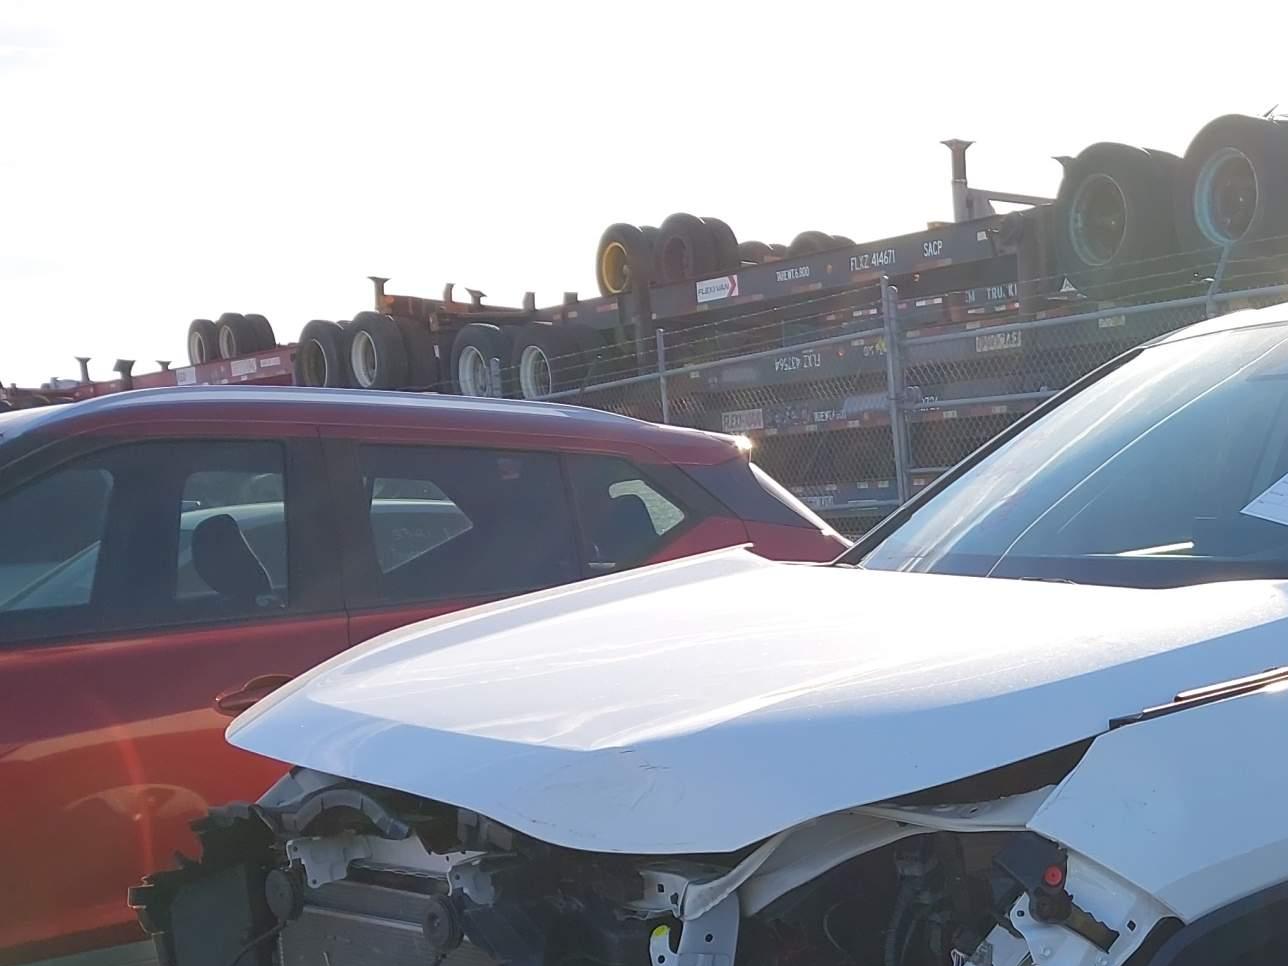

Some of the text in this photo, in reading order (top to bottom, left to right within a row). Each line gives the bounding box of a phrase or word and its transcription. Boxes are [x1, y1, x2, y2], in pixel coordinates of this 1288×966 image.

[923, 240, 943, 257] SACP
[850, 249, 896, 272] FLXZ 414671
